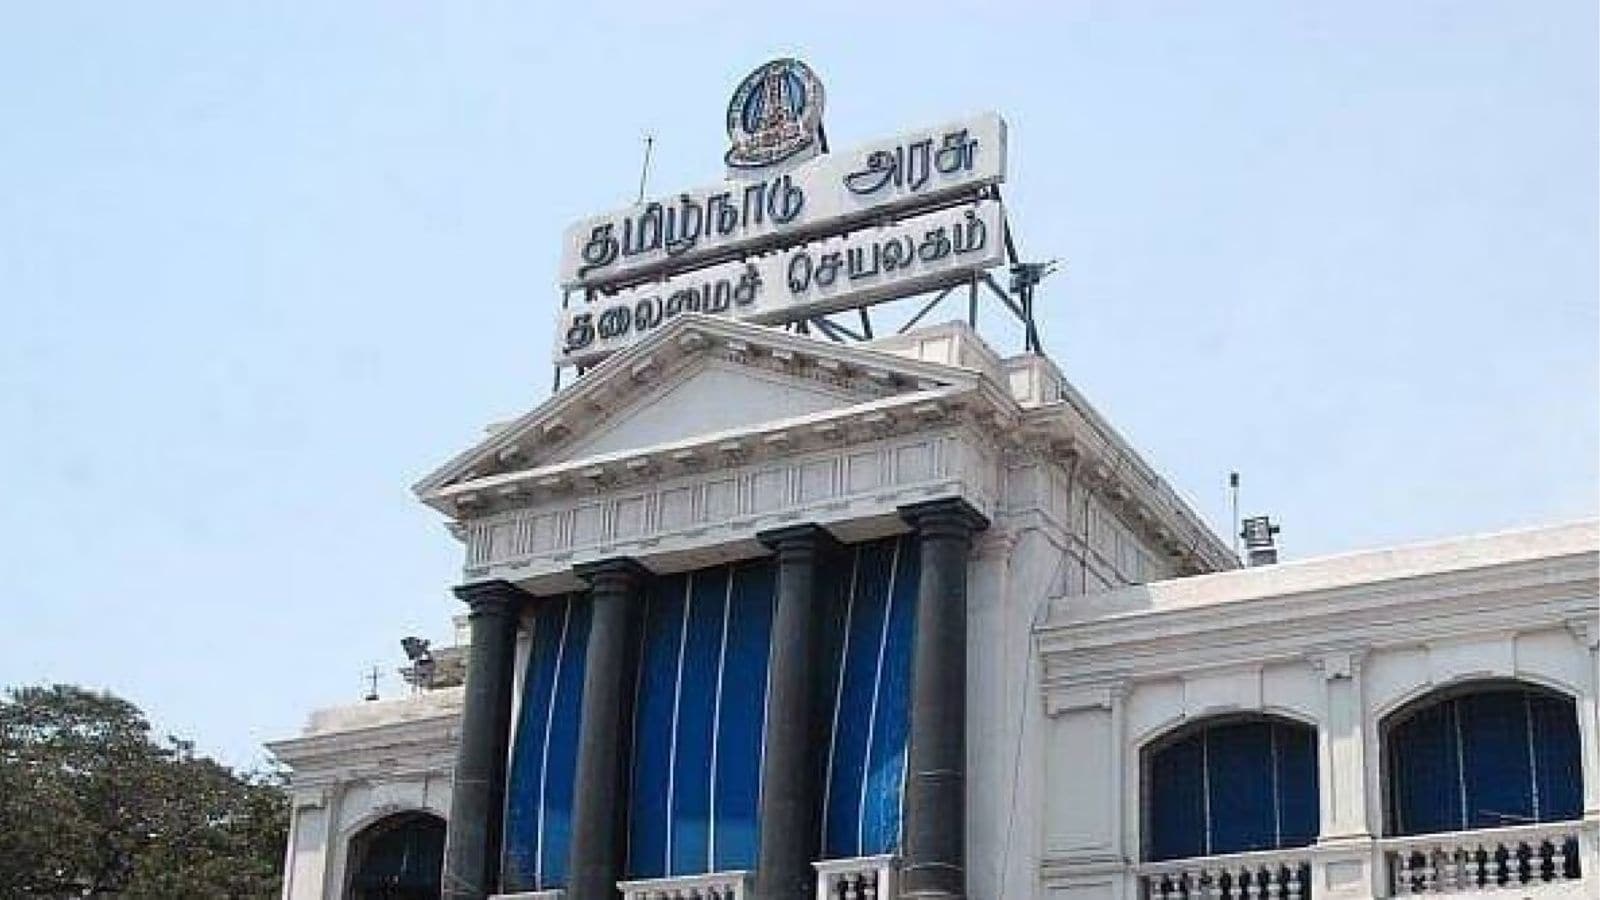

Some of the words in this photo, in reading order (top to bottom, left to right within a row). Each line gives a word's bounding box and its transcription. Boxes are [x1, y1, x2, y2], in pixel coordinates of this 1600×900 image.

[579, 175, 804, 279] தமிழ்நாடு
[843, 128, 978, 195] அரசு
[563, 263, 763, 355] தலைமைச்
[788, 209, 986, 293] செயலகம்
